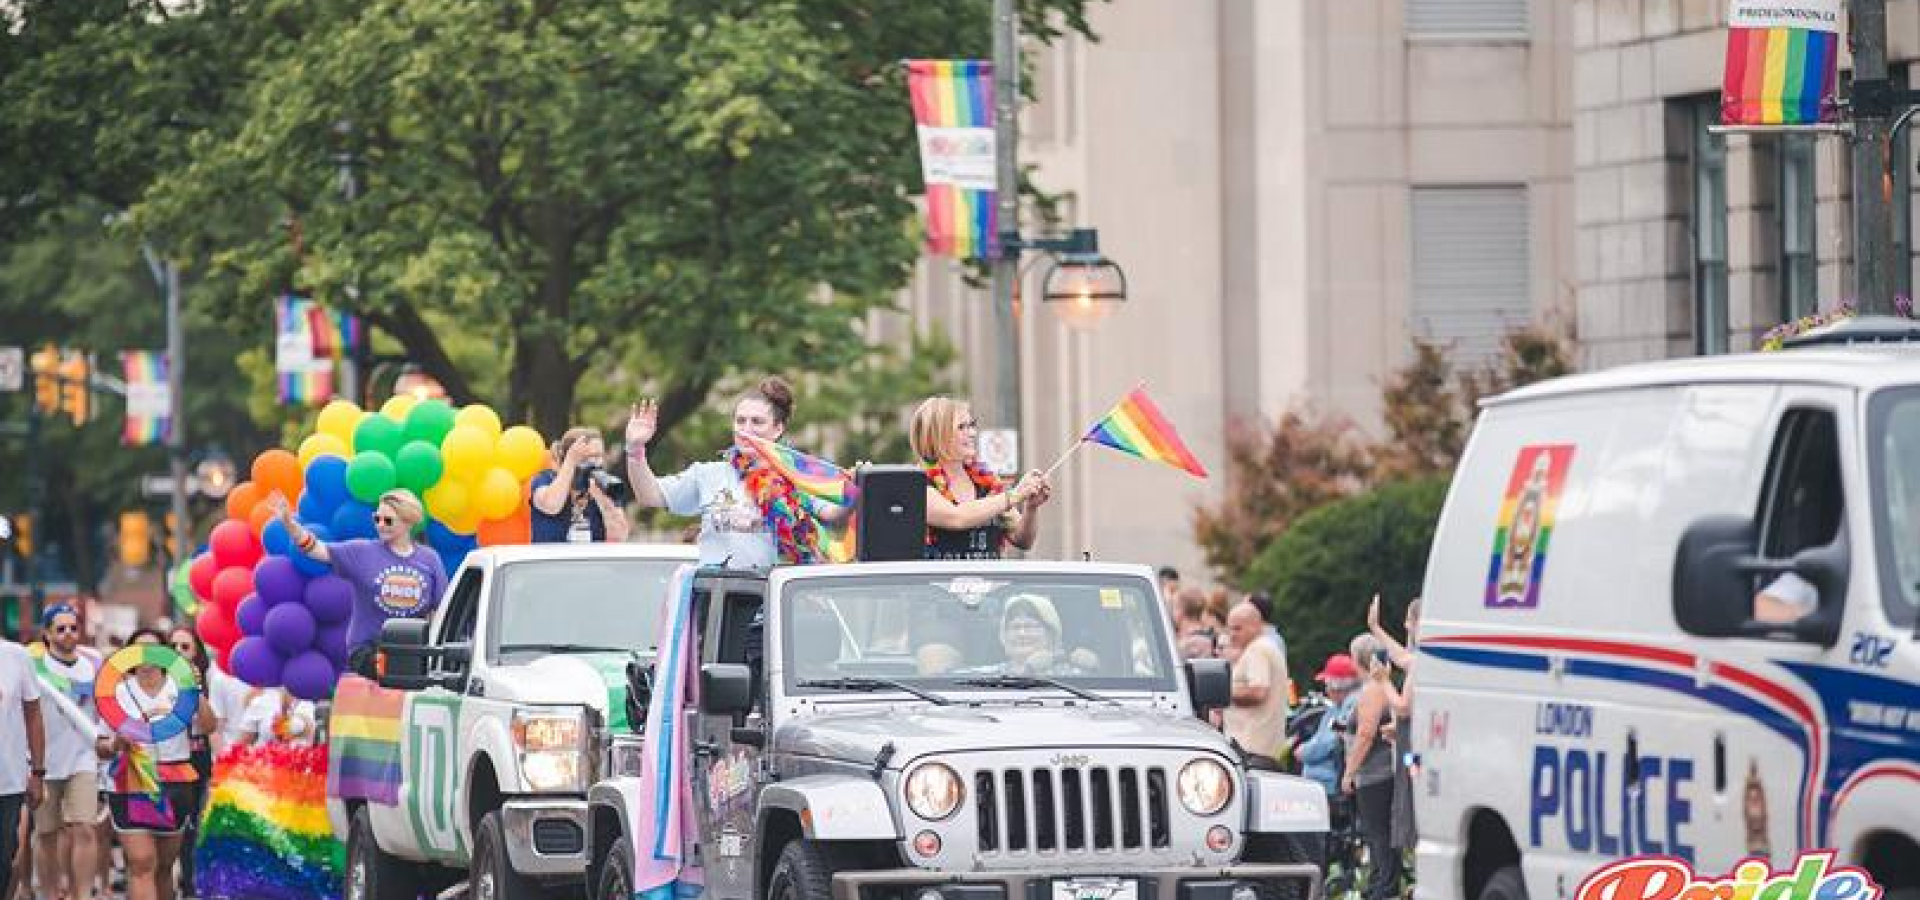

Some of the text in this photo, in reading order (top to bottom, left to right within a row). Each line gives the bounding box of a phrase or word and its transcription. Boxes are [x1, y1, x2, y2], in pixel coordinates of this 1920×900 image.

[1535, 702, 1594, 738] LONDON
[1049, 753, 1090, 768] Jeep
[1530, 745, 1696, 866] POLICE
